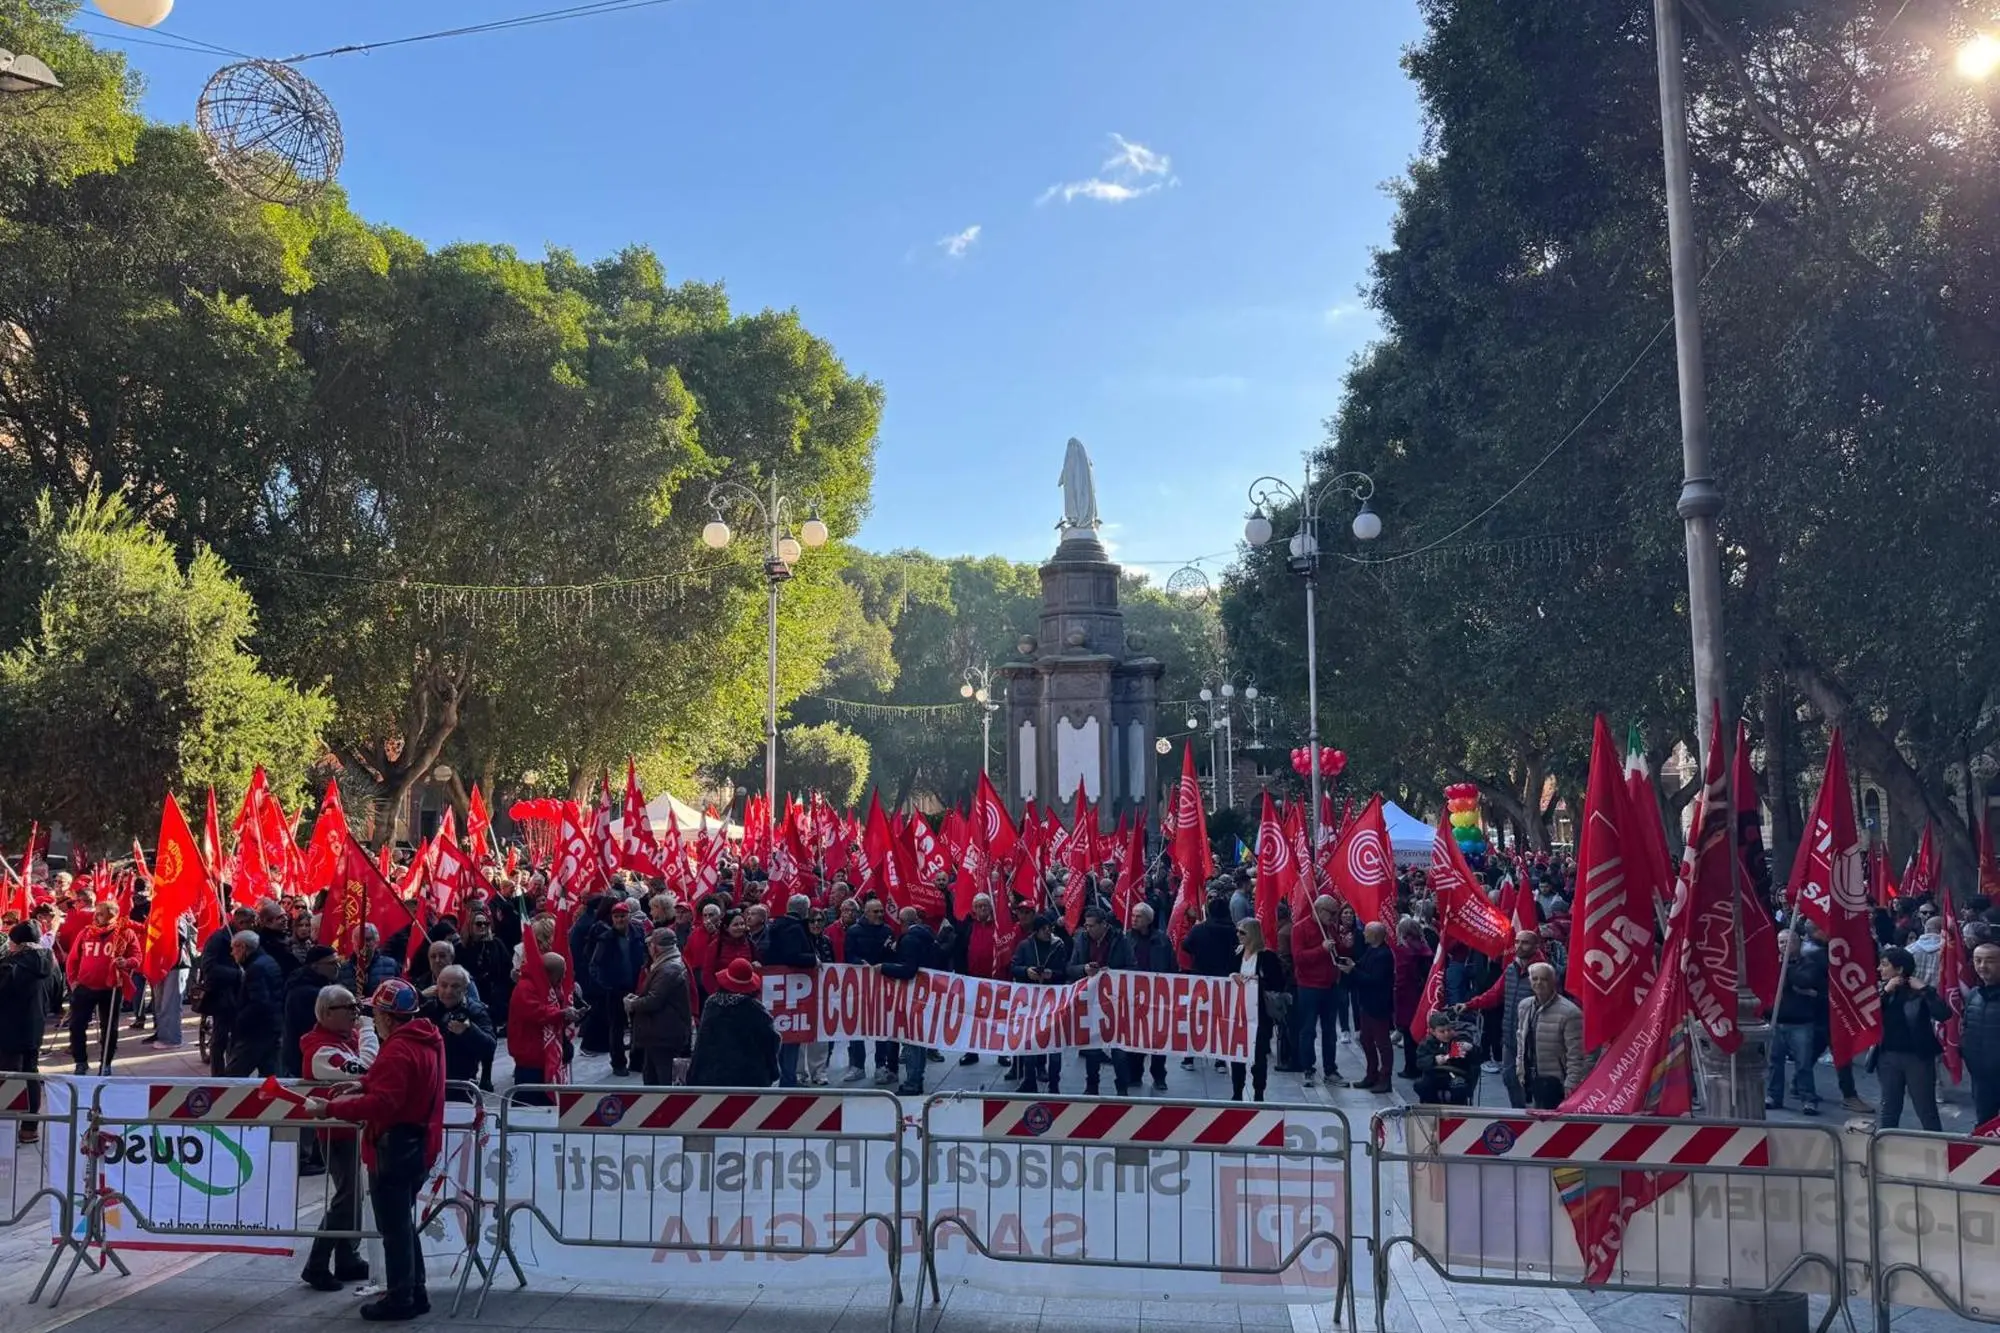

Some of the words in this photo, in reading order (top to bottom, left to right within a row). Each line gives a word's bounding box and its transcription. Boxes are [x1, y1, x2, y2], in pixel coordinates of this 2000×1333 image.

[84, 941, 116, 956] FIO
[1828, 937, 1883, 1027] CGIL
[772, 1013, 811, 1032] GIL
[823, 966, 966, 1047] COMPARTO
[972, 977, 1090, 1050] REGIONE
[1101, 971, 1248, 1059] SARDEGNA
